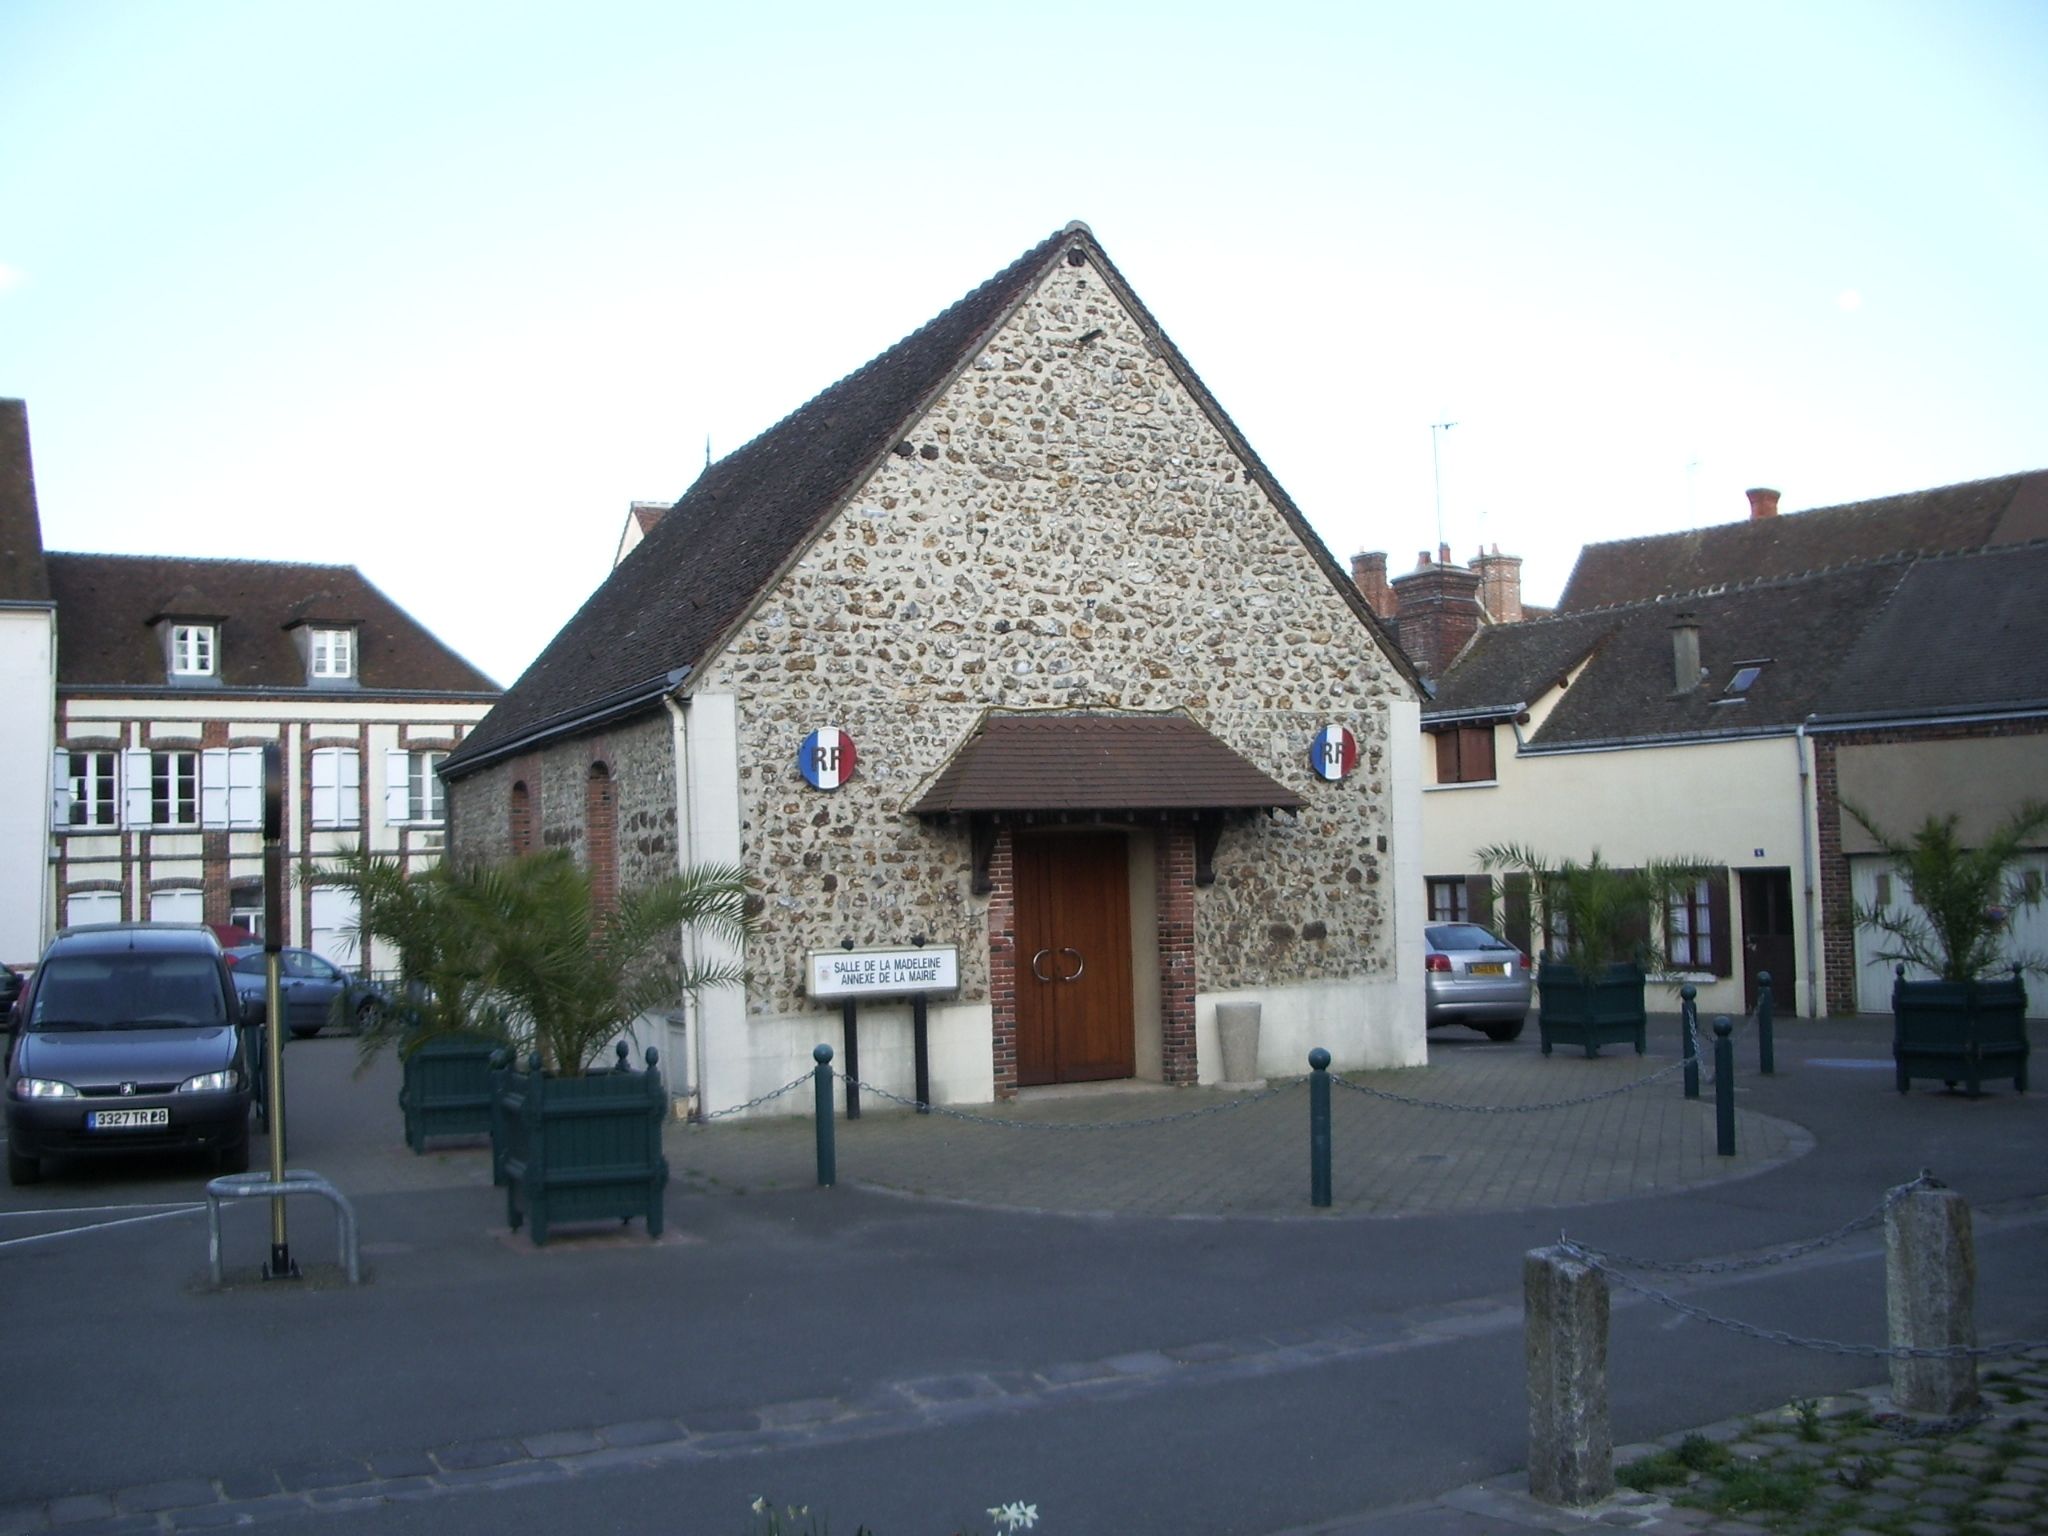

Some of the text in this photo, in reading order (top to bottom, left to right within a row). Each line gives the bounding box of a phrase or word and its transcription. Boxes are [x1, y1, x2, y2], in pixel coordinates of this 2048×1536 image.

[811, 746, 845, 771] RF
[1320, 742, 1345, 764] RF
[834, 957, 941, 973] SALLE DE LA MADELEINE
[841, 969, 937, 985] ANNEXE DE LA MAIRIE
[98, 1112, 130, 1125] 3327
[132, 1111, 148, 1124] TR
